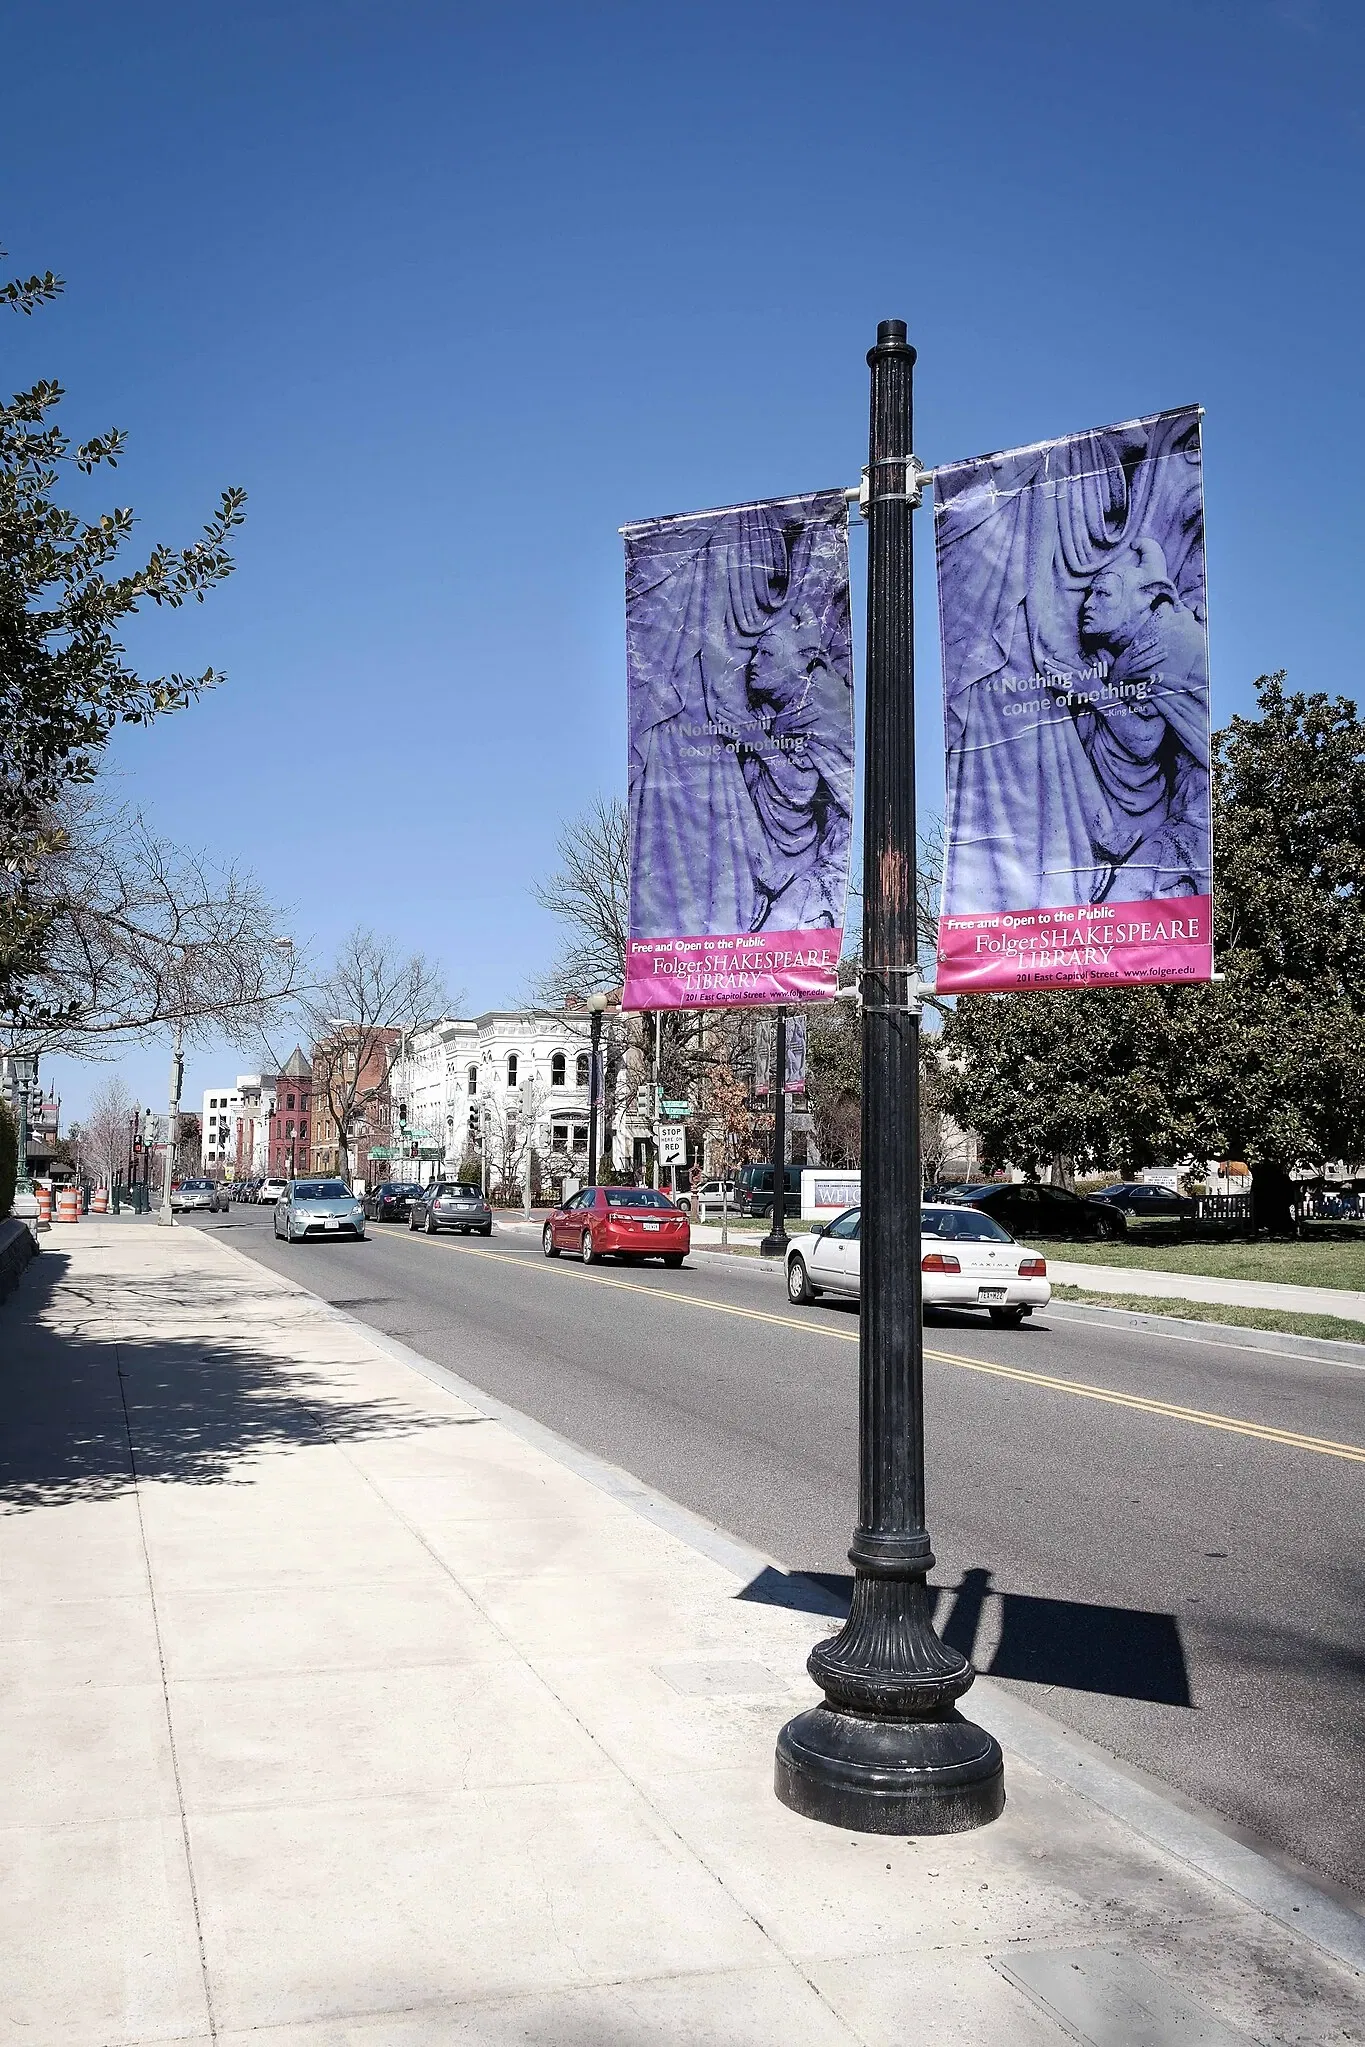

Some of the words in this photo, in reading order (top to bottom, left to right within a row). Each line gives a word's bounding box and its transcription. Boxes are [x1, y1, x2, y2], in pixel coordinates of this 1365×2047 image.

[1078, 661, 1108, 681] will
[1002, 699, 1051, 717] come
[1055, 690, 1074, 708] of
[1128, 703, 1147, 714] Lear
[746, 718, 771, 732] will
[678, 744, 721, 758] come
[725, 738, 742, 754] of
[947, 919, 974, 930] Free
[976, 916, 999, 928] and
[1002, 915, 1035, 929] Open
[1038, 913, 1051, 923] to
[1053, 911, 1075, 922] the
[1077, 906, 1116, 921] Public
[631, 942, 653, 953] Free
[654, 941, 673, 952] and
[674, 940, 702, 954] Open
[703, 940, 715, 950] to
[717, 938, 734, 949] the
[735, 936, 766, 949] Public
[1017, 945, 1115, 970] LIBRARY
[685, 970, 763, 991] LIBRARY
[1016, 973, 1031, 983] 201
[1034, 972, 1053, 981] East
[1055, 970, 1088, 982] Capitol
[1090, 970, 1119, 979] Street
[1124, 965, 1196, 977] www.folger.edu
[685, 993, 698, 1002] 201
[700, 993, 715, 1001] East
[716, 991, 742, 1003] Capitol
[743, 991, 766, 999] Street
[769, 988, 826, 999] www.folger.edu
[661, 1128, 682, 1136] STOP
